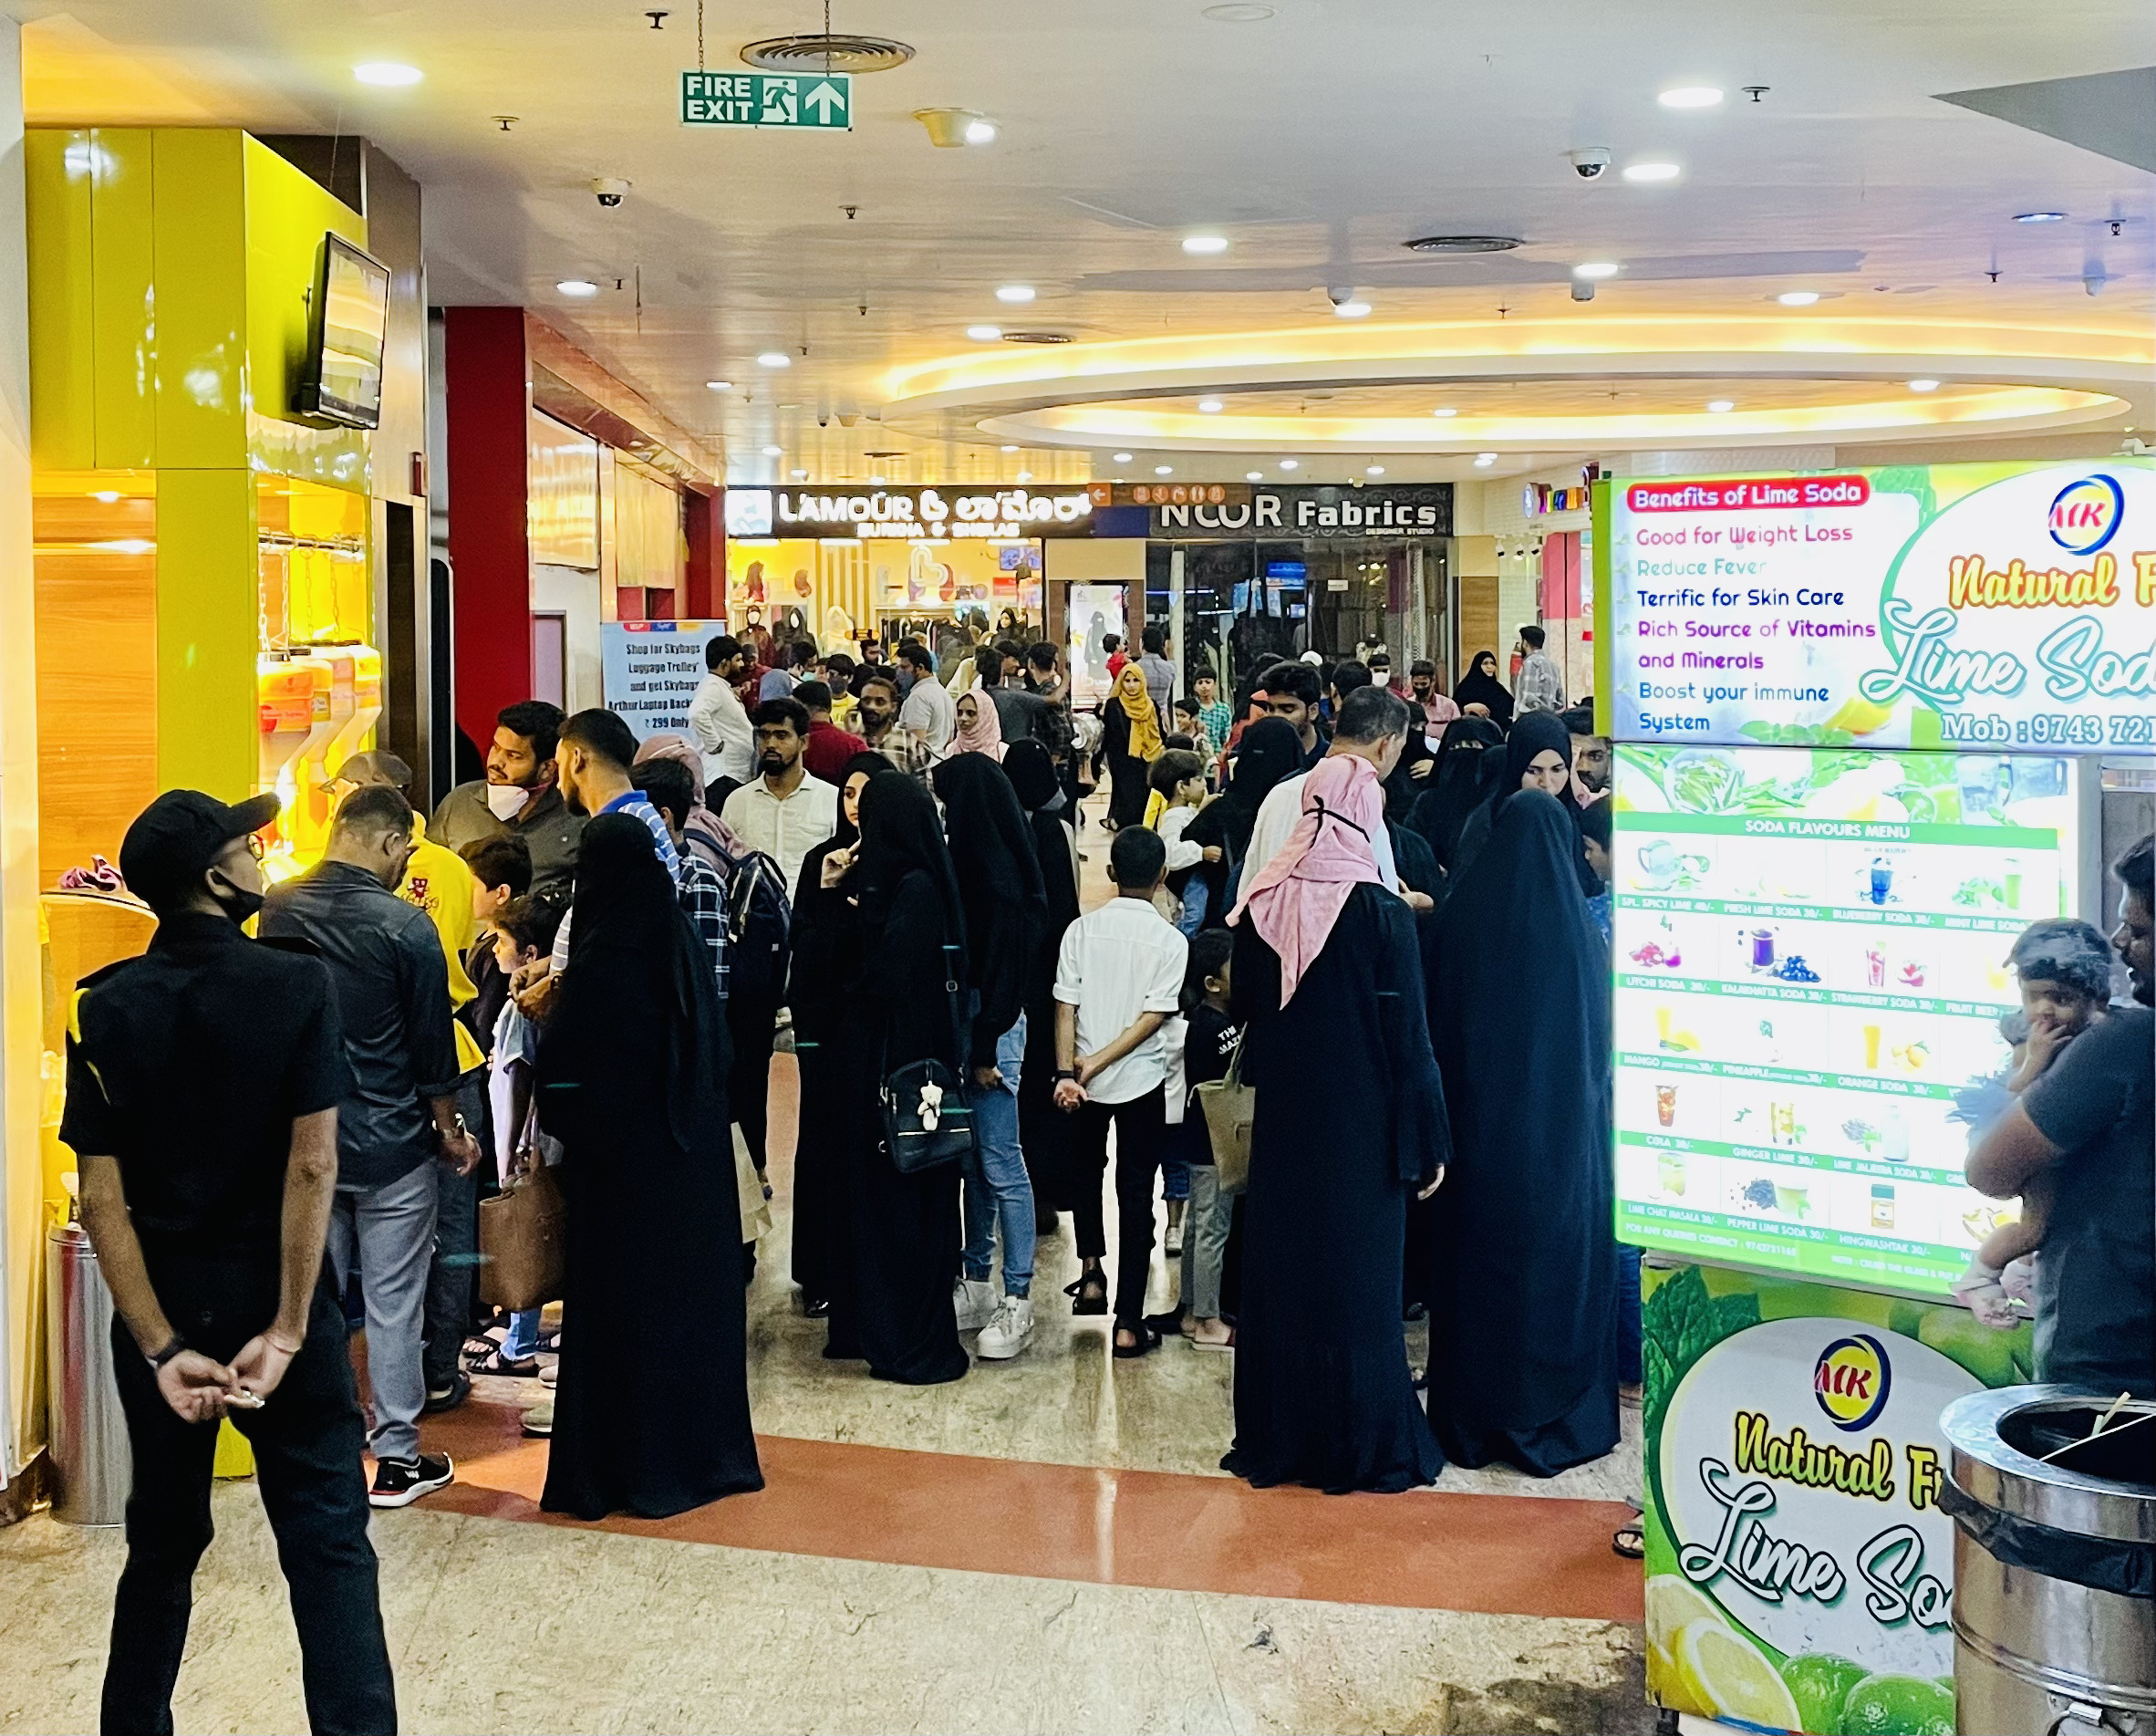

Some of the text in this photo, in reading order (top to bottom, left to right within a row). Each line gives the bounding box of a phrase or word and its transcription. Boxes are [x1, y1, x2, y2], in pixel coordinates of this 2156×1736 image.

[687, 77, 751, 97] FIRE
[687, 99, 753, 120] EXIT
[1634, 482, 1861, 508] Benefits of Lime Soda
[1298, 500, 1436, 526] Fabrics
[1636, 525, 1853, 546] Good for Weight Loss
[1637, 557, 1767, 577] Reduce Fever
[1949, 551, 2120, 610] Natural
[1637, 587, 1844, 608] Terrific for Skin Care
[1638, 619, 1876, 638] Rich Source of Vitamins
[627, 643, 700, 654] Shop for Skybags
[1859, 598, 2028, 704] Lime
[628, 662, 666, 674] Luggage
[1638, 651, 1764, 670] and Minerals
[630, 681, 647, 691] and
[648, 681, 663, 692] get
[1639, 682, 1829, 703] Boost your immune
[638, 700, 668, 711] Laptop
[652, 717, 669, 729] 299
[670, 717, 689, 729] Only
[1639, 712, 1710, 733] System
[1942, 713, 2011, 743] Mob
[1746, 820, 1911, 839] SODA FLAVOURS MENU
[1670, 899, 1692, 910] LIME
[1776, 906, 1802, 918] SODA
[1885, 911, 1912, 924] SODA
[1658, 979, 1685, 990] SODA
[1779, 988, 1806, 1000] SODA
[1891, 997, 1917, 1009] SODA
[1624, 1055, 1660, 1067] MANGO
[1881, 1080, 1908, 1093] SODA
[1646, 1136, 1672, 1148] COLA
[1733, 1147, 1771, 1161] GINGER
[1726, 1218, 1757, 1231] PEPPER
[1781, 1225, 1808, 1239] SODA
[1815, 1360, 1871, 1400] MK
[1735, 1410, 1894, 1502] Natural
[1678, 1457, 1953, 1631] Lime So
